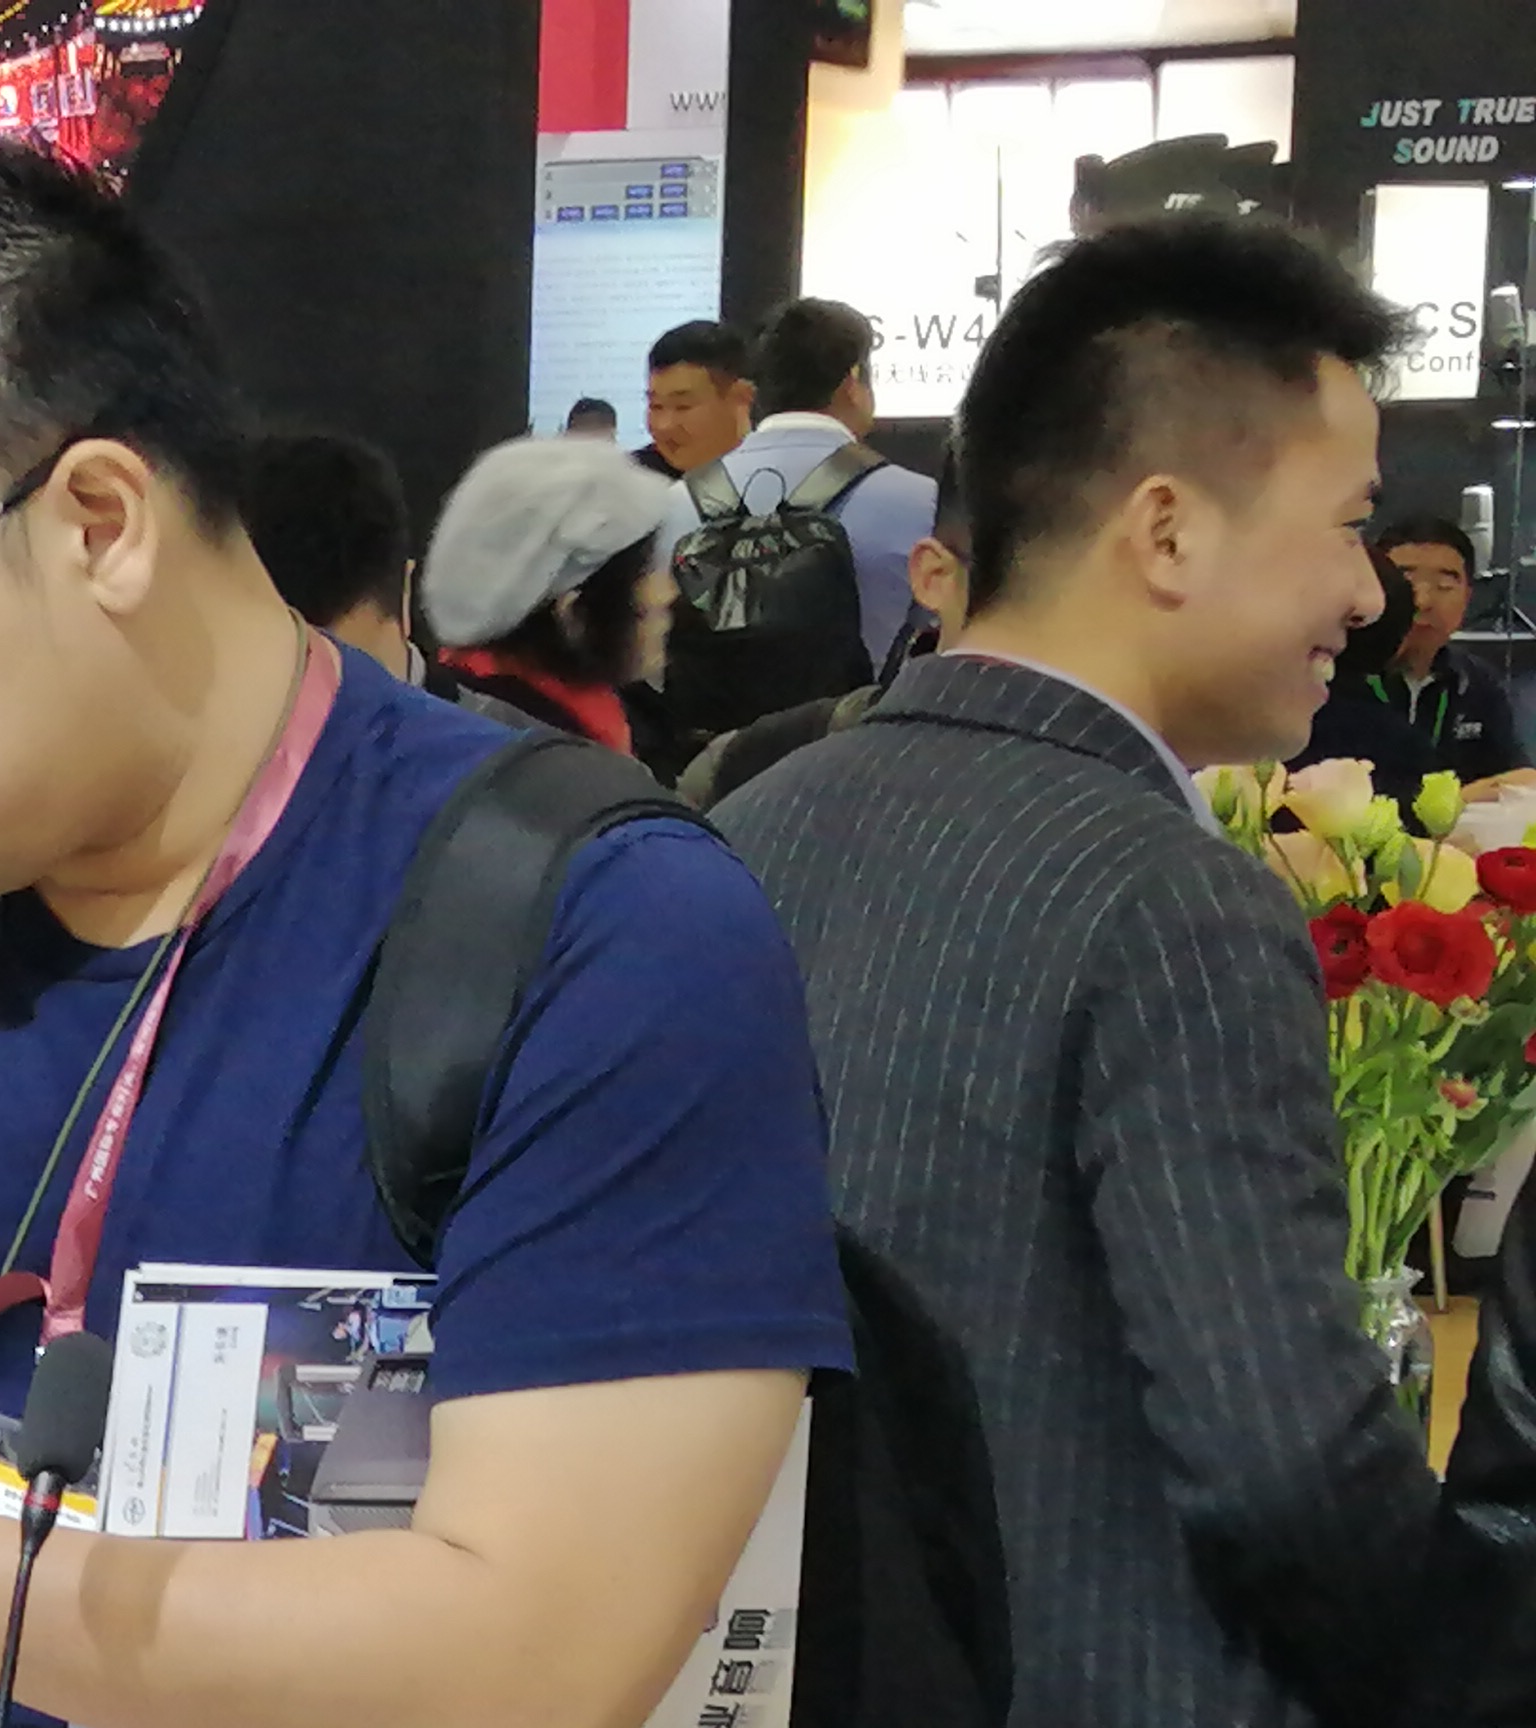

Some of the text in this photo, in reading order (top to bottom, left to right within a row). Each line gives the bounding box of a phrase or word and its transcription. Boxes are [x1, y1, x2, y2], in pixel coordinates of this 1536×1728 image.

[670, 91, 726, 112] WW
[1360, 97, 1536, 128] JUST TRUE
[1393, 136, 1500, 165] SOUND
